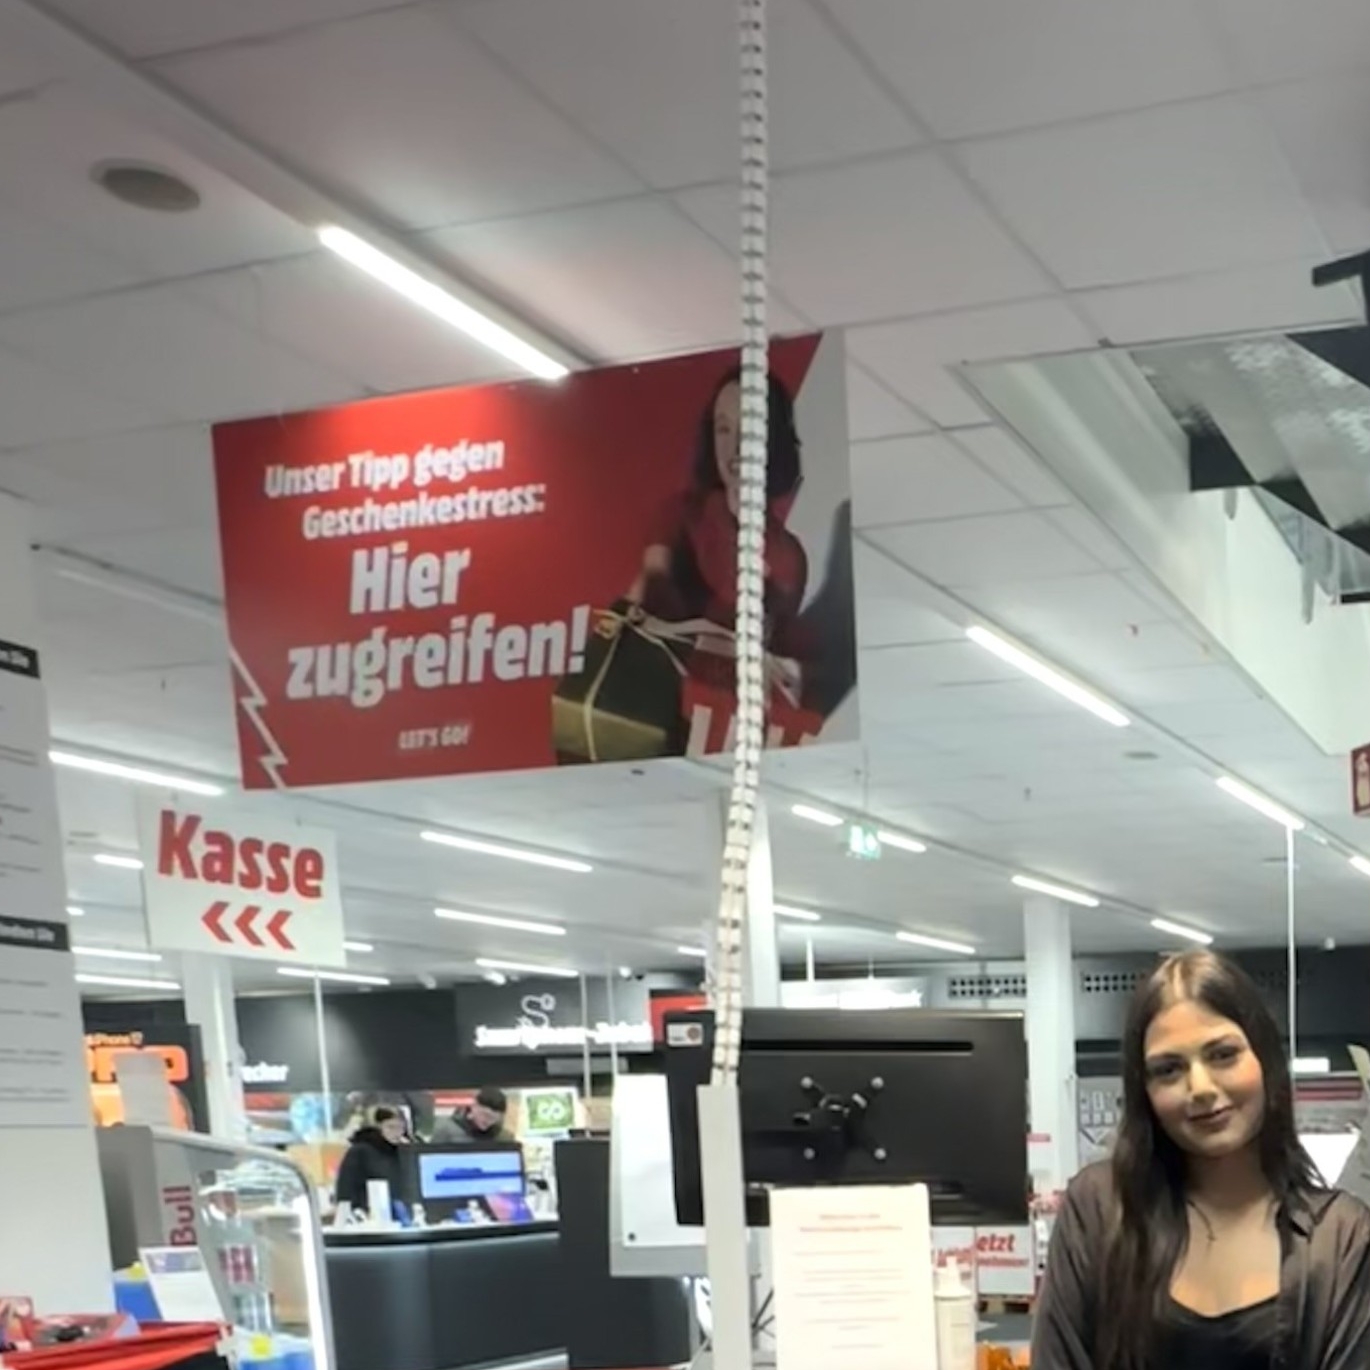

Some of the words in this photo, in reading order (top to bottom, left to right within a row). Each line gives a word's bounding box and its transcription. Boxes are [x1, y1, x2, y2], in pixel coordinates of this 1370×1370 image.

[264, 464, 344, 498] Unser
[347, 450, 409, 493] Tipp
[413, 437, 504, 487] gegen
[302, 482, 546, 541] Geschenkestress:
[349, 541, 471, 616] Hier
[285, 605, 592, 708] zugreifen!
[399, 727, 438, 750] LET'S
[440, 724, 470, 747] GO!
[157, 809, 325, 899] Kasse
[163, 1185, 198, 1247] Bull
